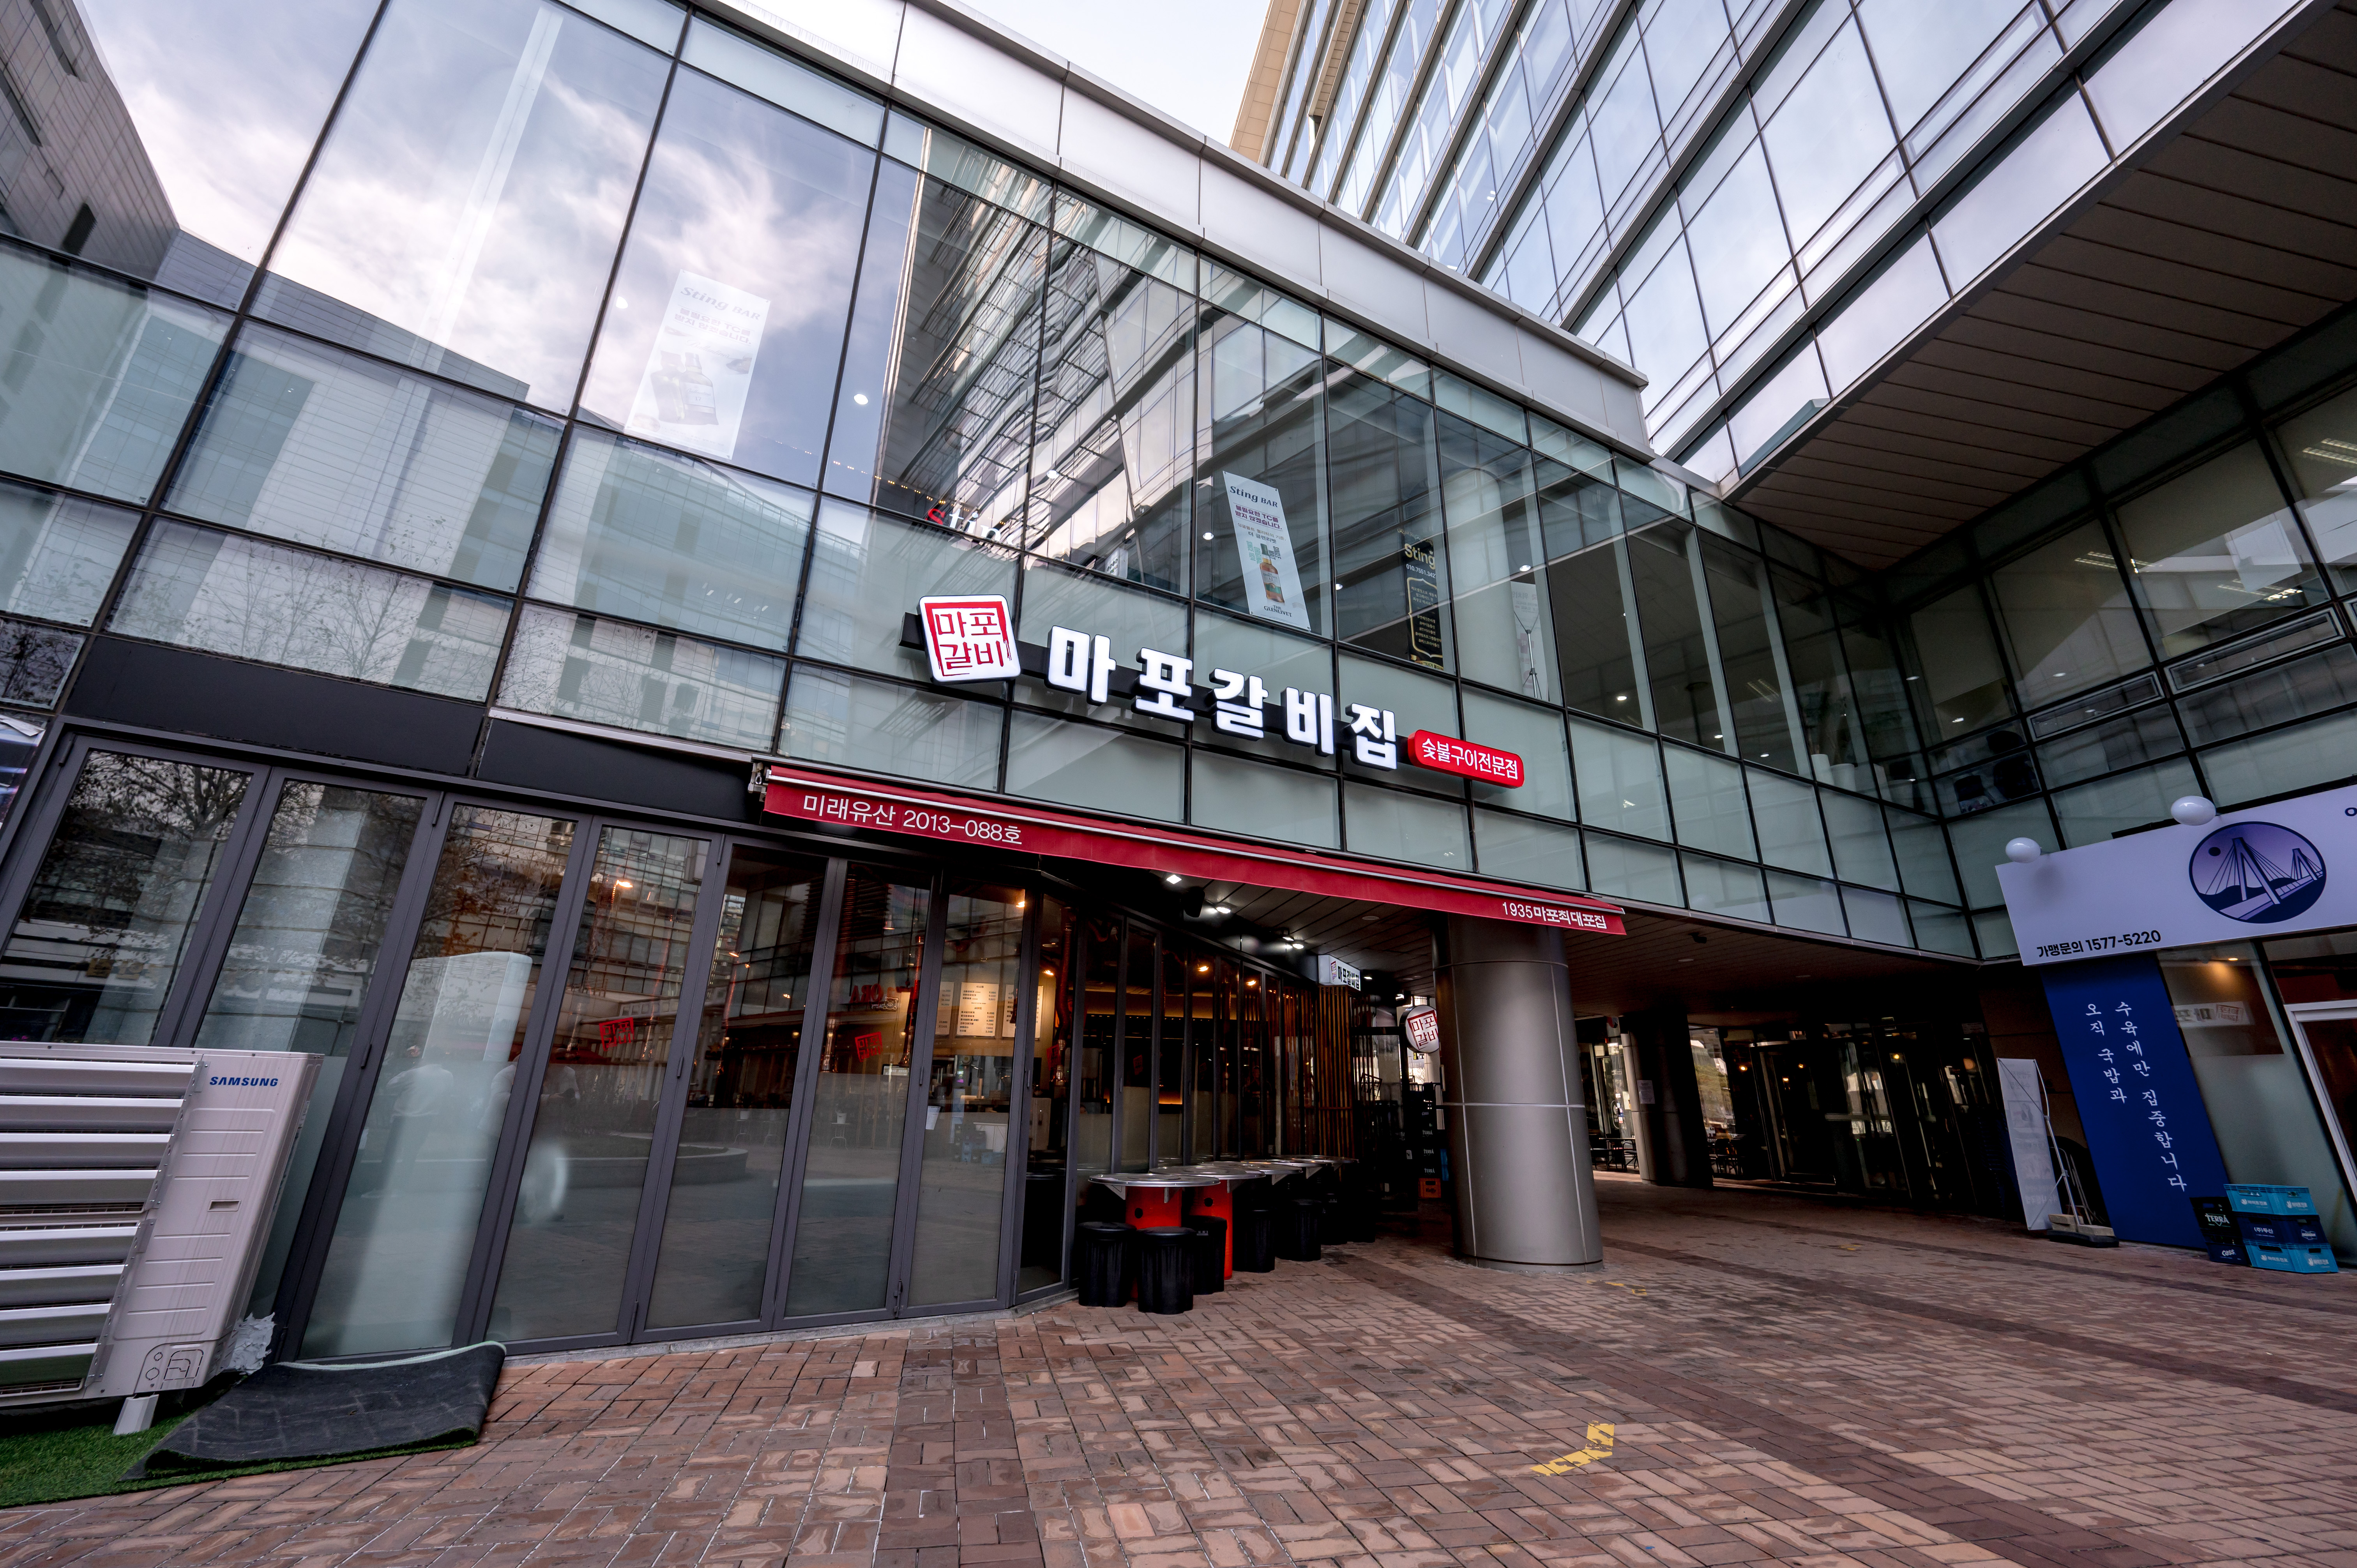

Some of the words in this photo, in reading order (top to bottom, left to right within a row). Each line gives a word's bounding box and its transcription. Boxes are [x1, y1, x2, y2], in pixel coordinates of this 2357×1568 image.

[680, 287, 729, 311] Sting
[732, 306, 760, 320] BAR
[675, 313, 695, 326] 받지
[679, 307, 721, 326] 불필요한
[1230, 486, 1258, 503] Sting
[1261, 497, 1278, 508] BAR
[1235, 510, 1247, 519] 받지
[1236, 505, 1260, 517] 불필요한
[1262, 513, 1279, 523] TC를
[1255, 533, 1277, 544] 글렌리벳
[1405, 544, 1436, 570] Sting
[1264, 606, 1292, 617] GLENLIVET
[936, 613, 998, 637] 마포
[940, 639, 1006, 668] 갈비
[1048, 625, 1398, 771] 마포갈비집
[1422, 737, 1519, 781] 숯불구이전문점
[804, 795, 896, 826] 미래유산
[903, 809, 1022, 845] 2013-088호
[1502, 902, 1607, 929] 1935마포최대포집
[2037, 941, 2084, 959] 가맹문의
[2085, 930, 2161, 952] 1577-5220
[1338, 966, 1359, 989] 마포갈비집
[1412, 1016, 1437, 1033] 마포
[1415, 1029, 1439, 1047] 갈비
[2086, 1003, 2105, 1036] 오직
[2099, 1049, 2127, 1104] 국밥과
[210, 1076, 278, 1087] SAMSUNG
[2115, 1002, 2150, 1077] 수육에만
[2142, 1089, 2187, 1192] 집중합니다
[2205, 1213, 2230, 1224] TERRA
